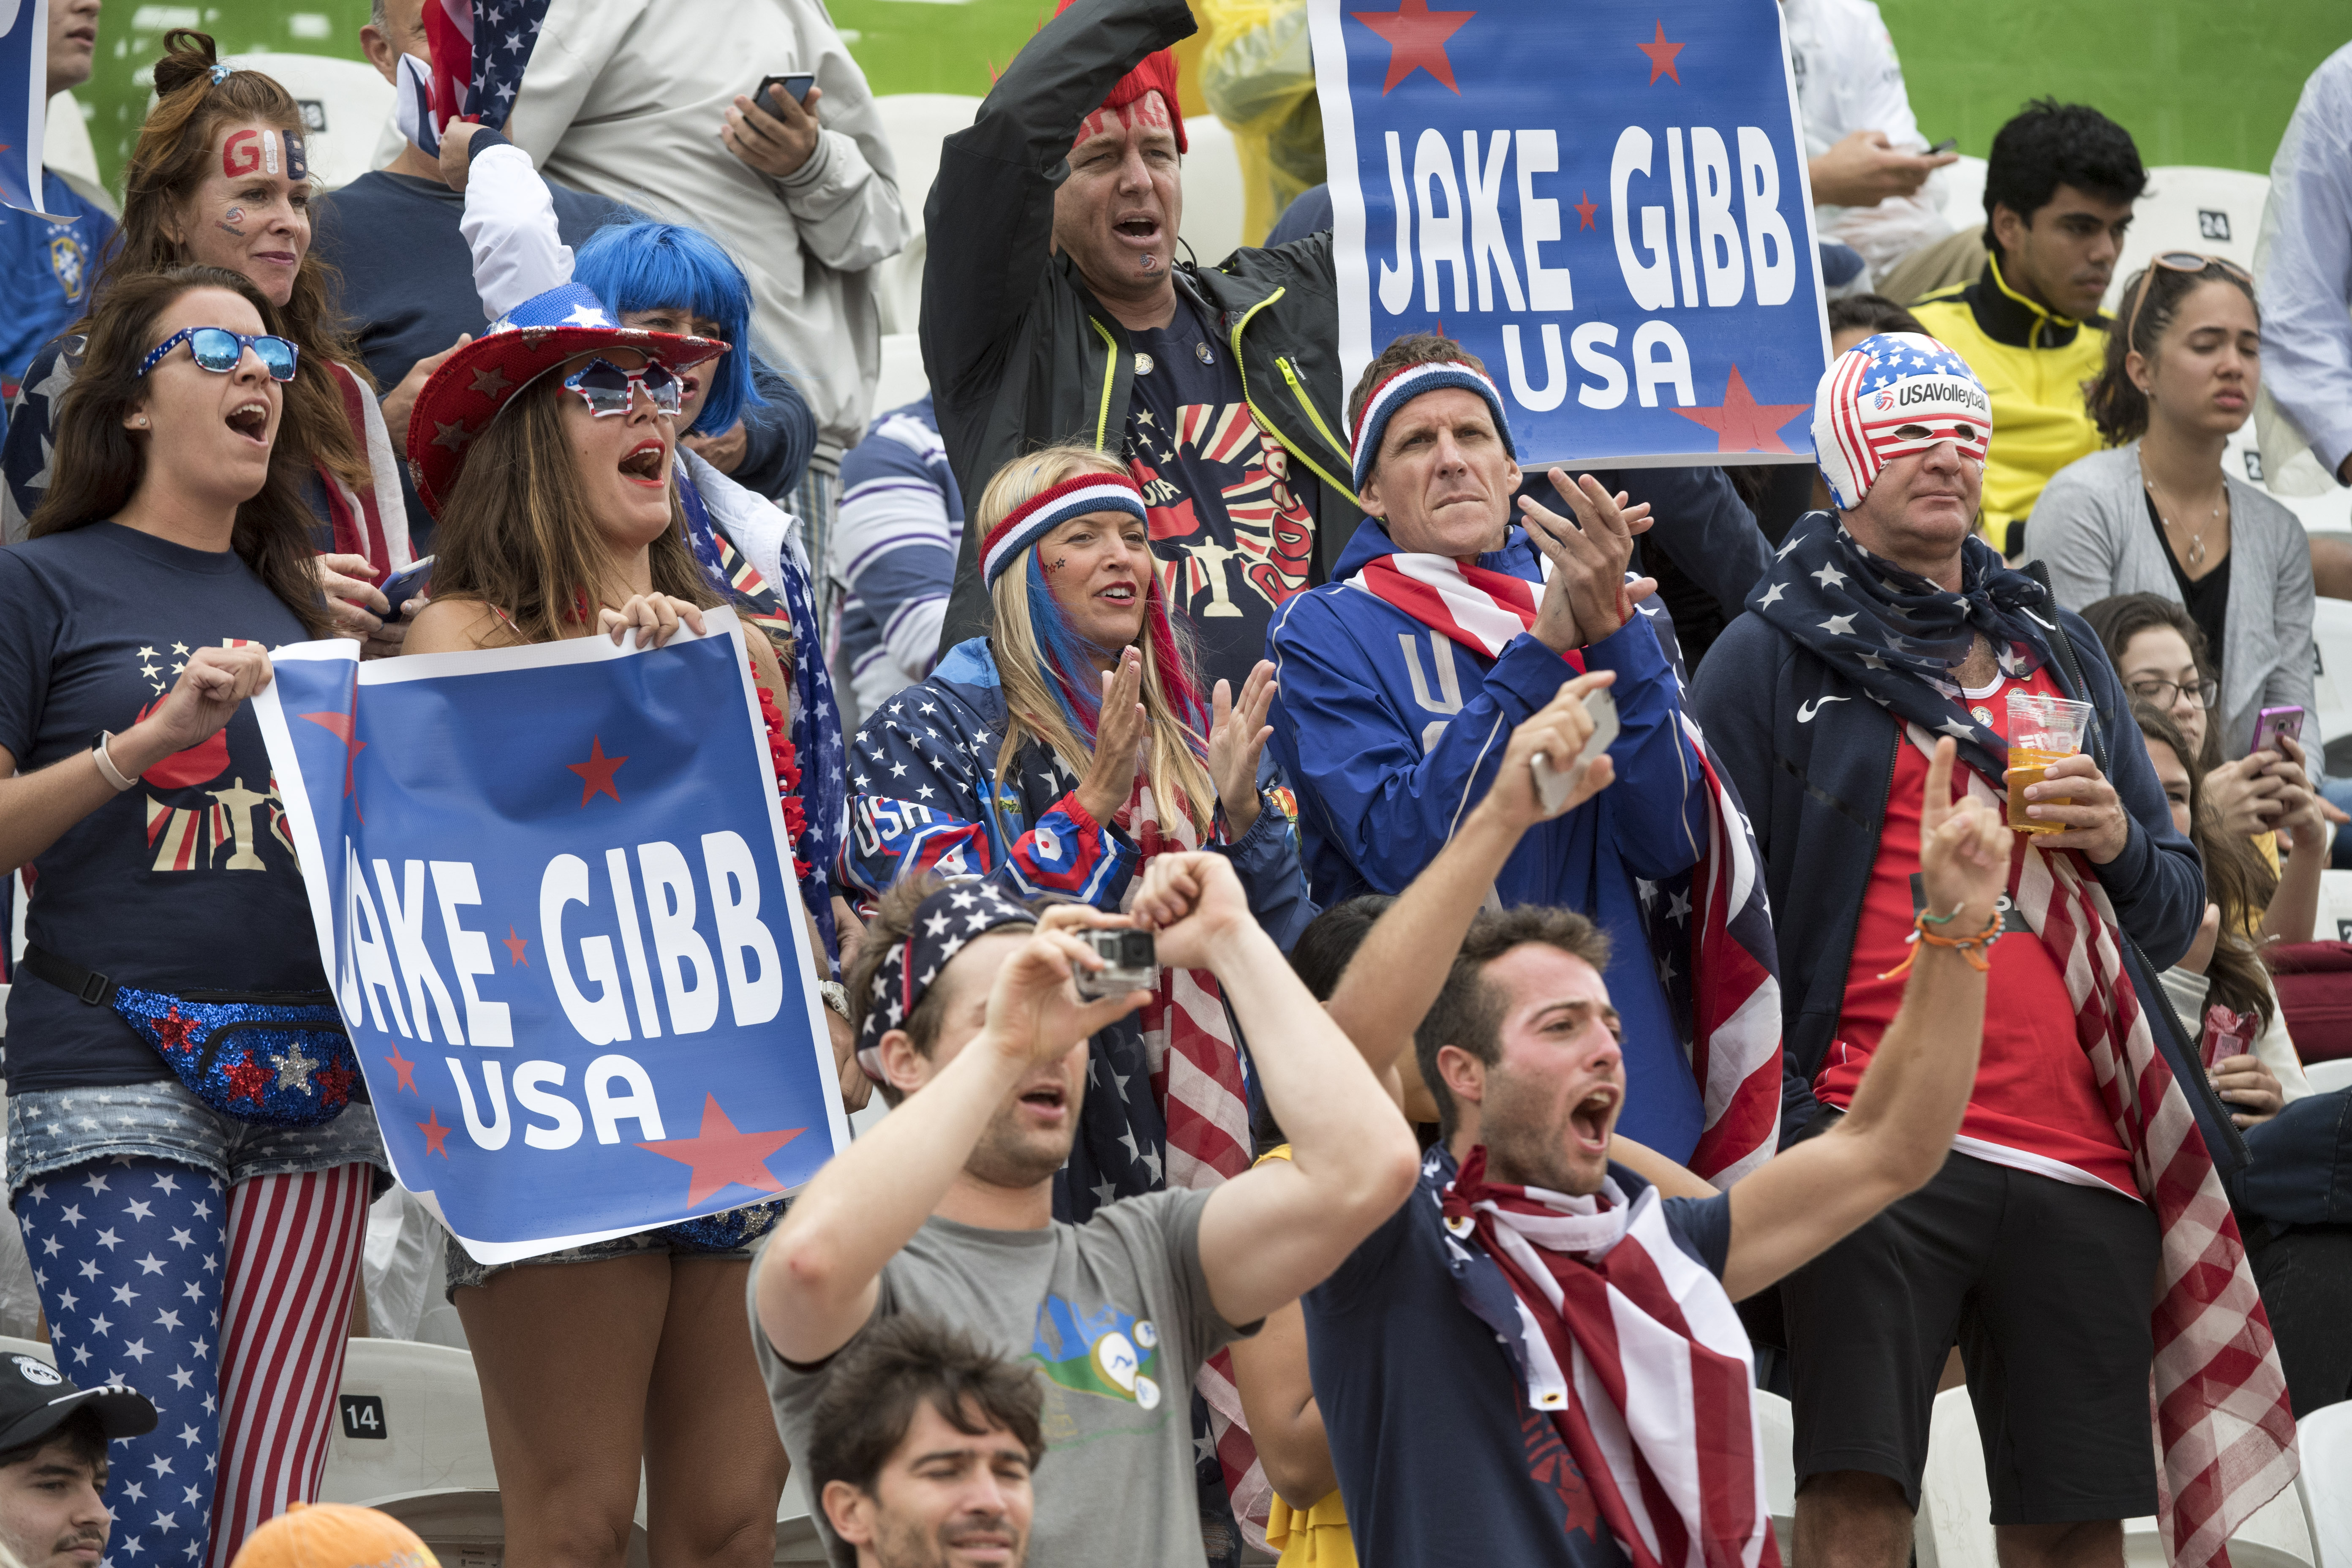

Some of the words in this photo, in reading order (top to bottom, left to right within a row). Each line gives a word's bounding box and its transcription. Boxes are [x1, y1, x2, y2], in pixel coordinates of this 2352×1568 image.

[1379, 128, 1573, 315] JAKE
[1610, 125, 1796, 311] GIBB
[2200, 210, 2229, 238] 24
[1502, 320, 1696, 412] USA
[1900, 383, 1986, 413] USAVolleyball
[1143, 478, 1182, 506] USA
[854, 796, 932, 858] USA
[341, 835, 514, 1048] JAKE
[539, 830, 783, 1046] GIBB
[445, 1054, 666, 1151] USA
[346, 1404, 379, 1430] 14
